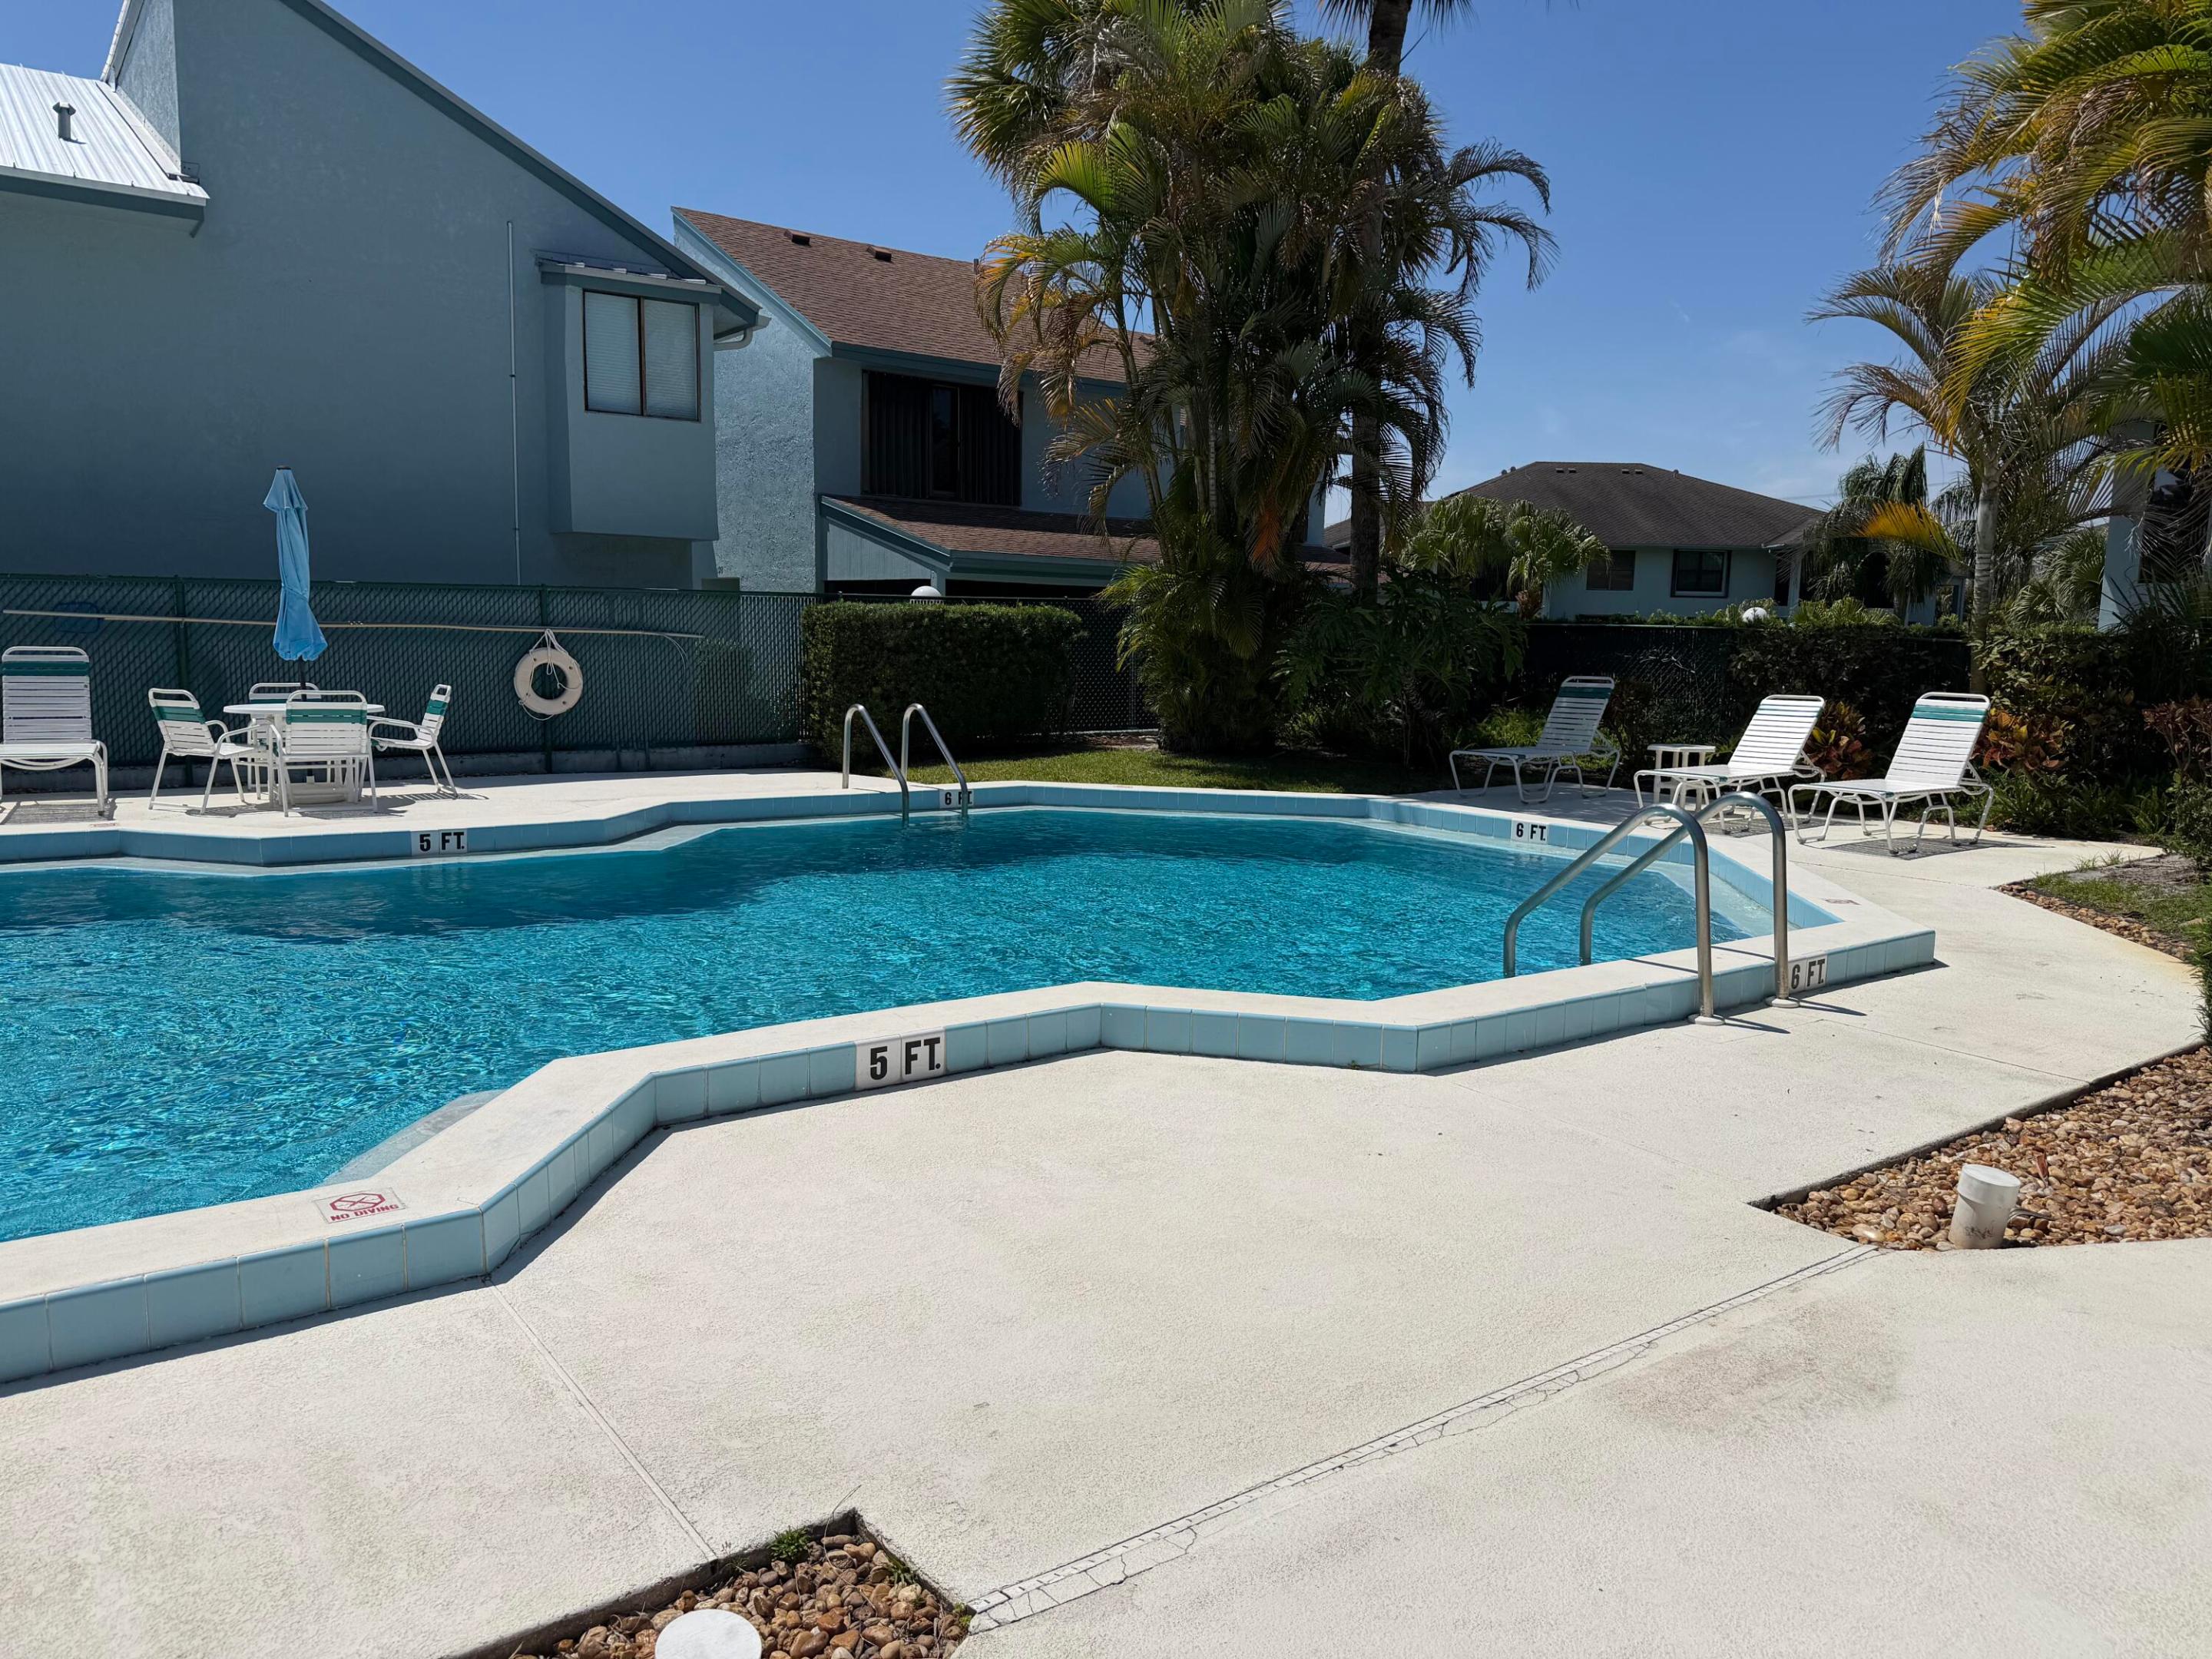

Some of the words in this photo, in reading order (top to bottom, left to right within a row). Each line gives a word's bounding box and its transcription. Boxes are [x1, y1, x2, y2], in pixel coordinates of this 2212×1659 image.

[945, 792, 952, 805] 6
[1516, 823, 1524, 837] 6
[419, 833, 431, 852] 5
[441, 832, 465, 850] FT.
[1791, 964, 1800, 989] 6
[869, 1045, 888, 1081] 5
[905, 1037, 941, 1075] FT.
[330, 1213, 349, 1221] NO
[354, 1204, 399, 1217] DIVING
